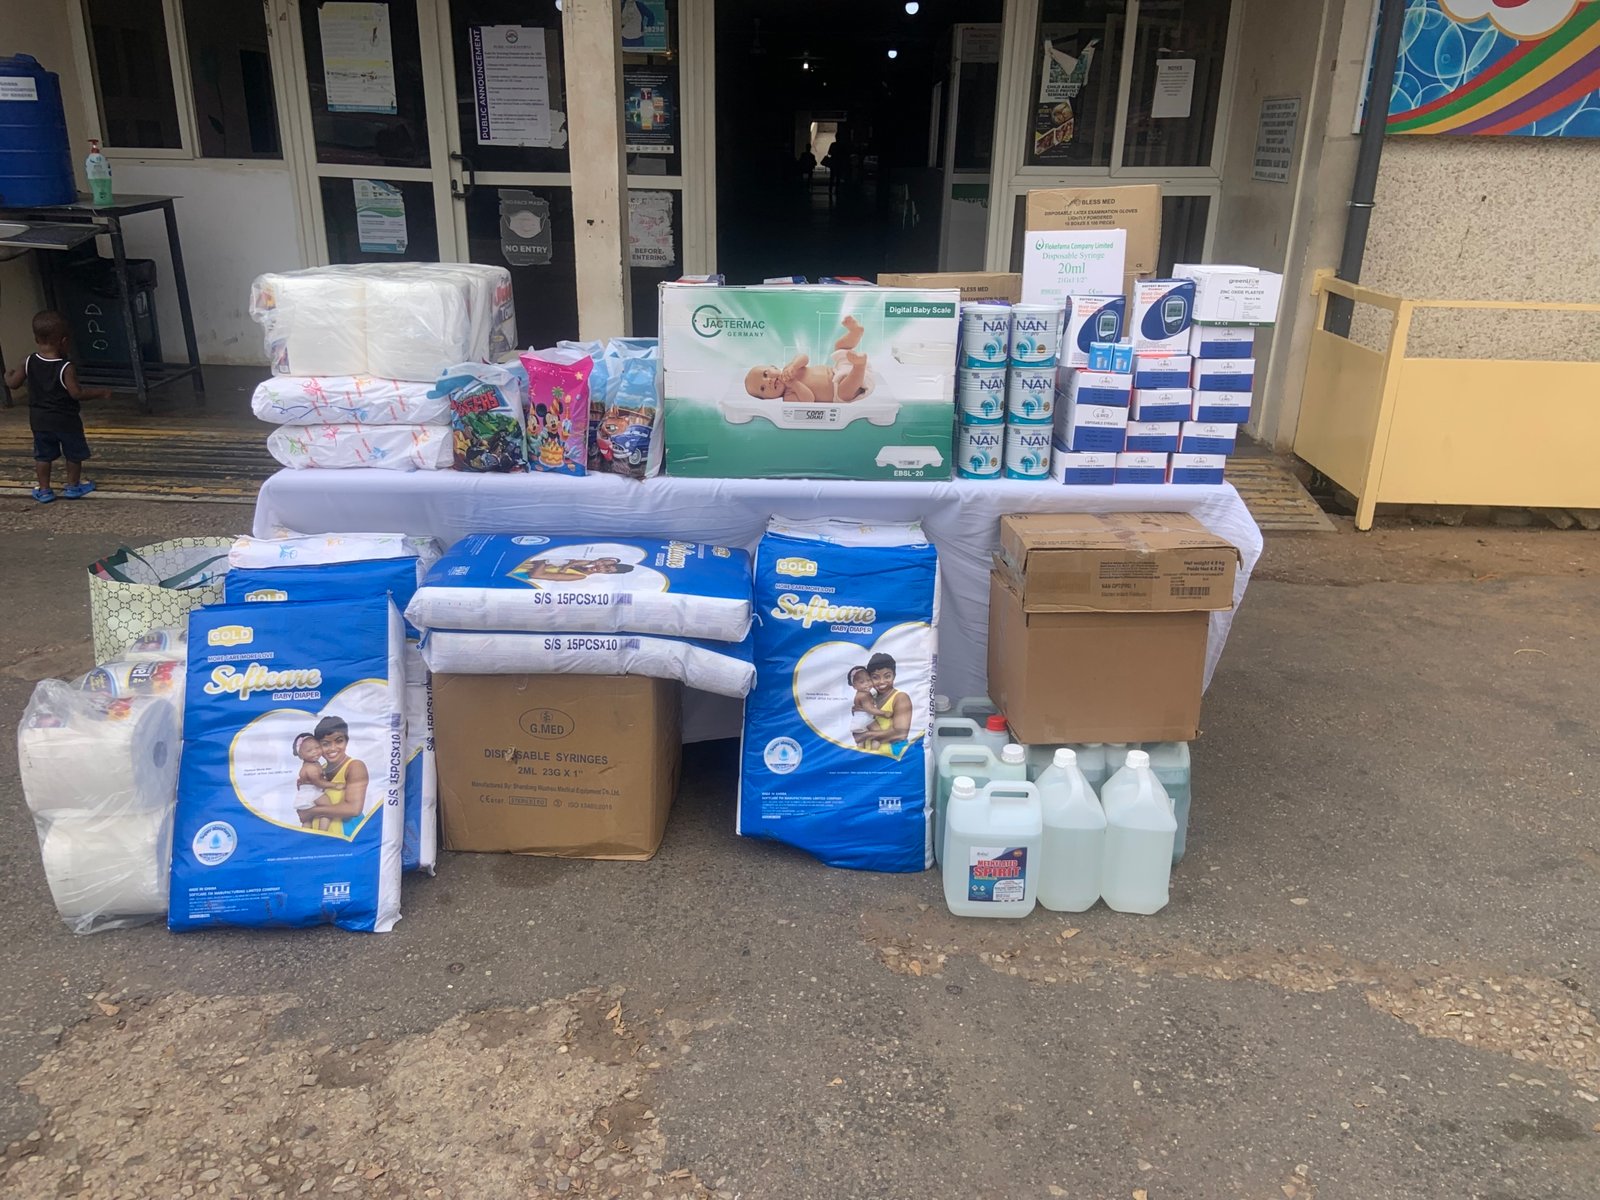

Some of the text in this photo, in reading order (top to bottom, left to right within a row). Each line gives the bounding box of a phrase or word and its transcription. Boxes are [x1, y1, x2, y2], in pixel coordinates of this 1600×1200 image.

[473, 29, 489, 139] PUBLIC ANNOUNCEMENT
[505, 244, 548, 254] NO ENTRY
[1042, 252, 1105, 261] Disposable Syringe
[1057, 262, 1086, 274] 20ml
[889, 306, 952, 315] Digital Baby Scale
[703, 318, 766, 329] JACTERMAC
[1016, 320, 1048, 331] NAN
[1022, 379, 1052, 390] NAN
[969, 435, 1000, 446] NAN
[1020, 436, 1050, 446] NAN
[779, 561, 815, 572] GOLD
[248, 593, 285, 601] GOLD
[534, 592, 552, 605] S/S
[771, 593, 876, 629] Softcare
[210, 630, 250, 641] GOLD
[544, 637, 562, 651] S/S
[204, 663, 321, 700] Softcare
[530, 723, 565, 735] G.MED
[484, 748, 608, 765] DISPSABLE SYRINGES
[518, 766, 537, 776] 2ML
[542, 768, 561, 777] 23G
[563, 769, 570, 777] X
[576, 787, 602, 796] Equipment
[388, 789, 399, 807] S/S
[974, 866, 1021, 877] SPIRIT
